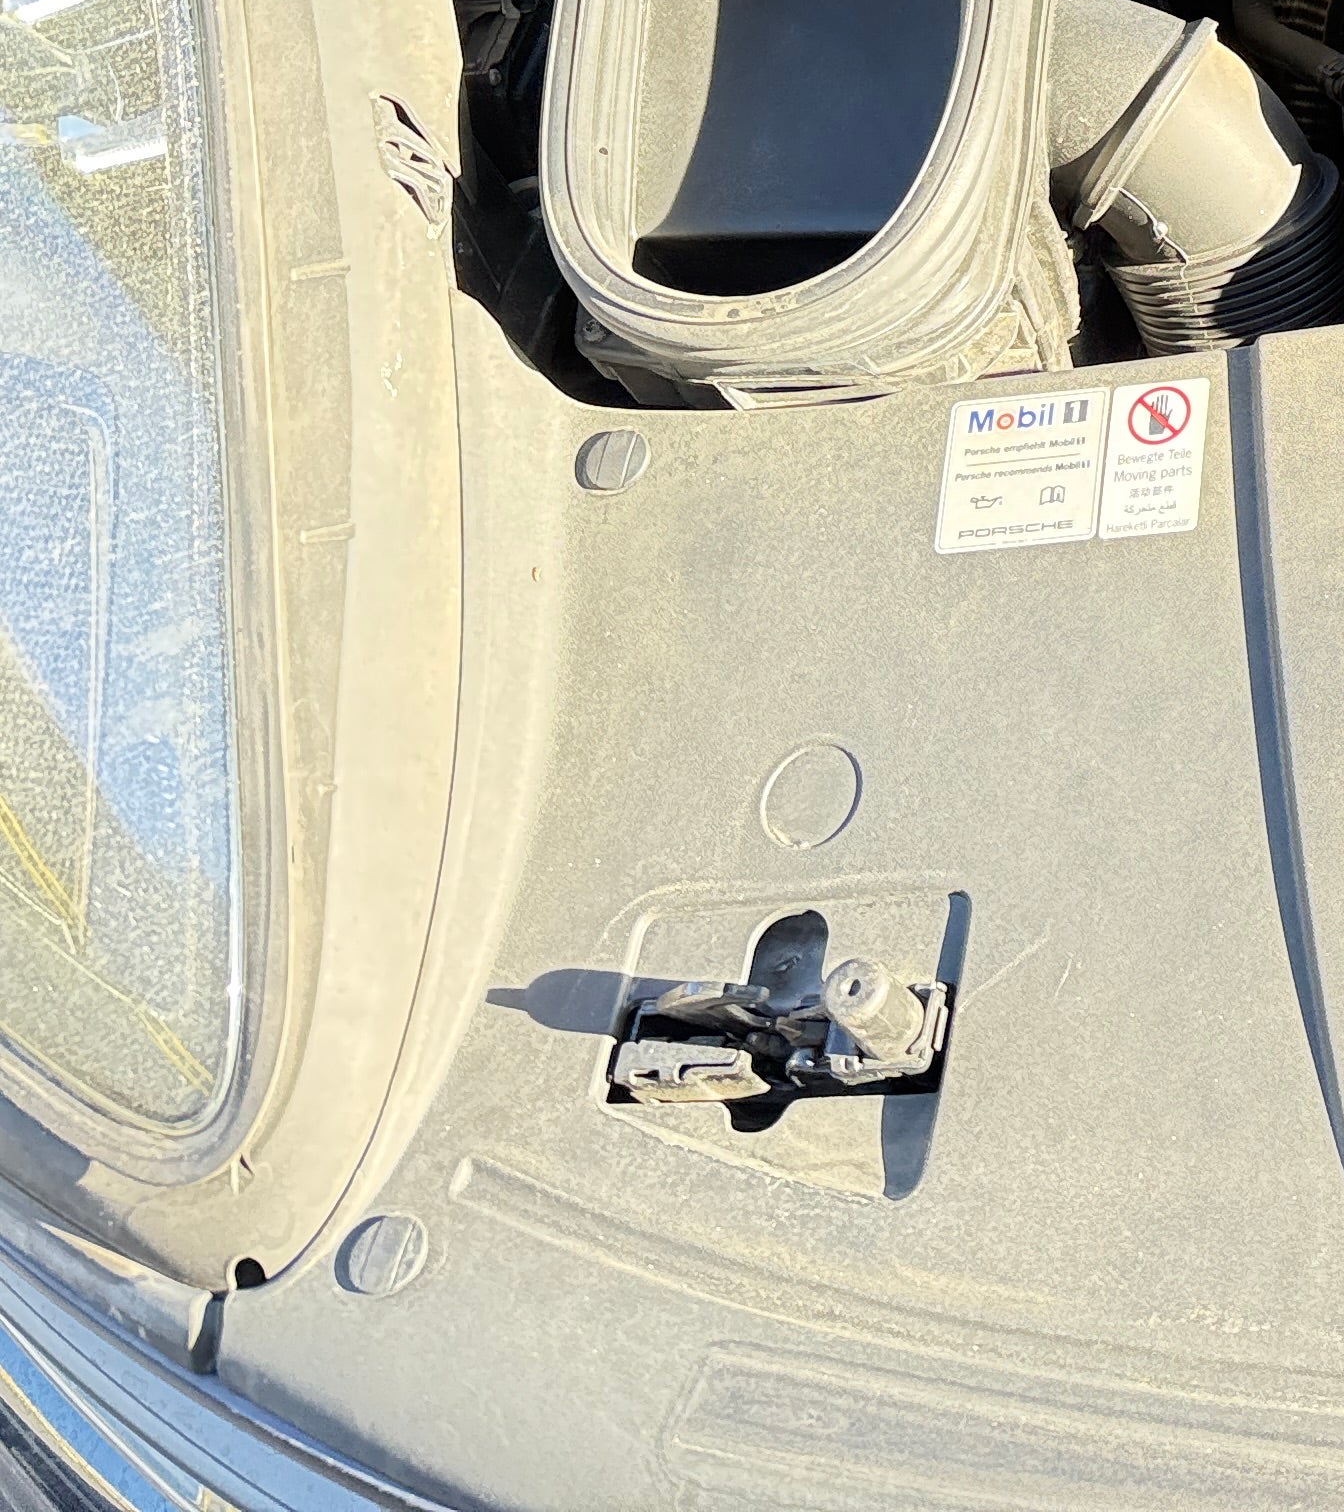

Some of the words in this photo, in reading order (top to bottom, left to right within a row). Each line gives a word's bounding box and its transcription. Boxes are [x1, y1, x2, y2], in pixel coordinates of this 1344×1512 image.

[968, 403, 1054, 433] Mobil
[1064, 399, 1088, 424] 1
[964, 446, 1000, 456] Porsche
[1004, 441, 1046, 453] empfiehlt
[1049, 437, 1075, 448] Mobil
[1117, 451, 1164, 465] Bewegte
[1168, 448, 1192, 459] Teile
[955, 471, 991, 482] Porsche
[994, 465, 1052, 478] recommends
[1055, 461, 1080, 471] Mobil
[1113, 469, 1157, 483] Moving
[1160, 465, 1192, 480] parts
[958, 520, 1074, 539] PORSCHE
